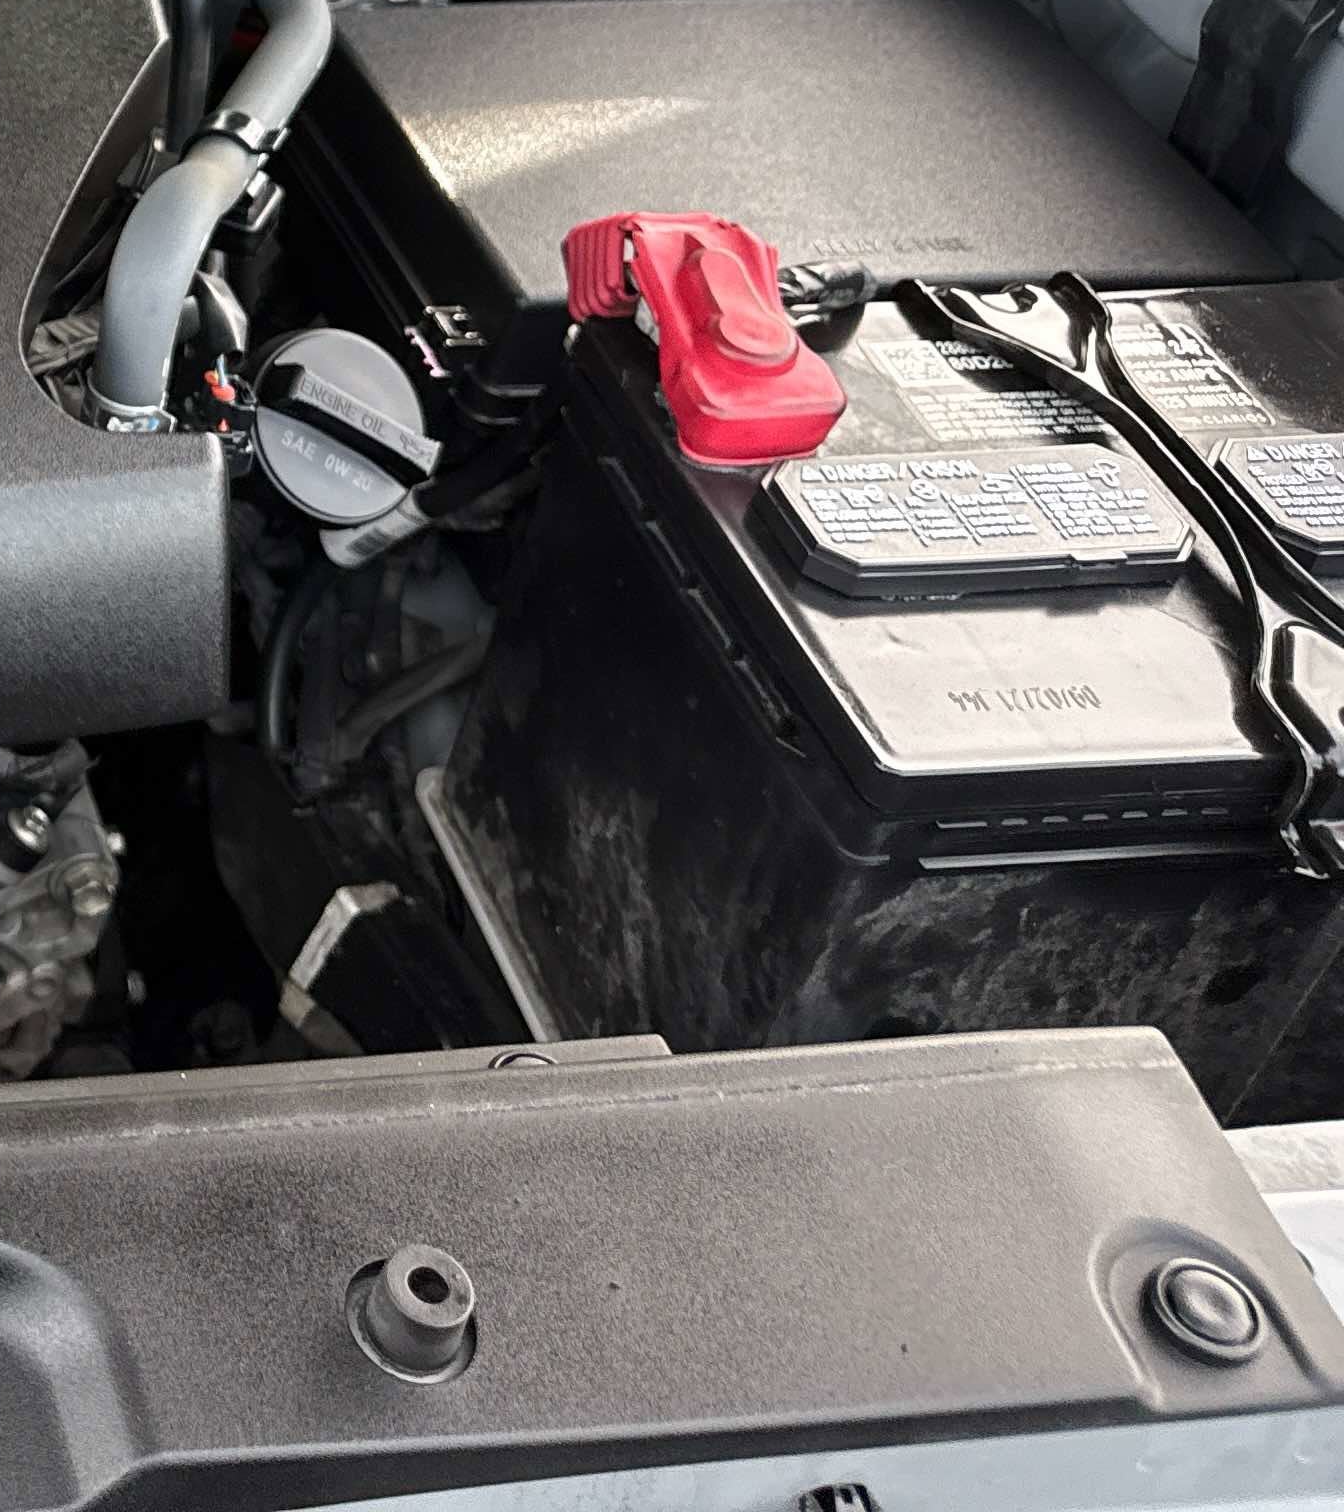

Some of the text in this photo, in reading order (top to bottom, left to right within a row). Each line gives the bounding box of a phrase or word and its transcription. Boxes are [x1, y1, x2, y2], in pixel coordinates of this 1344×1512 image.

[300, 376, 386, 436] ENGINE OIL
[1184, 392, 1255, 408] MINUTES
[1201, 413, 1268, 426] CLARIOS
[280, 429, 317, 463] SAE
[1264, 442, 1342, 463] DANGER
[819, 462, 897, 483] DANGER
[907, 458, 980, 480] POISON
